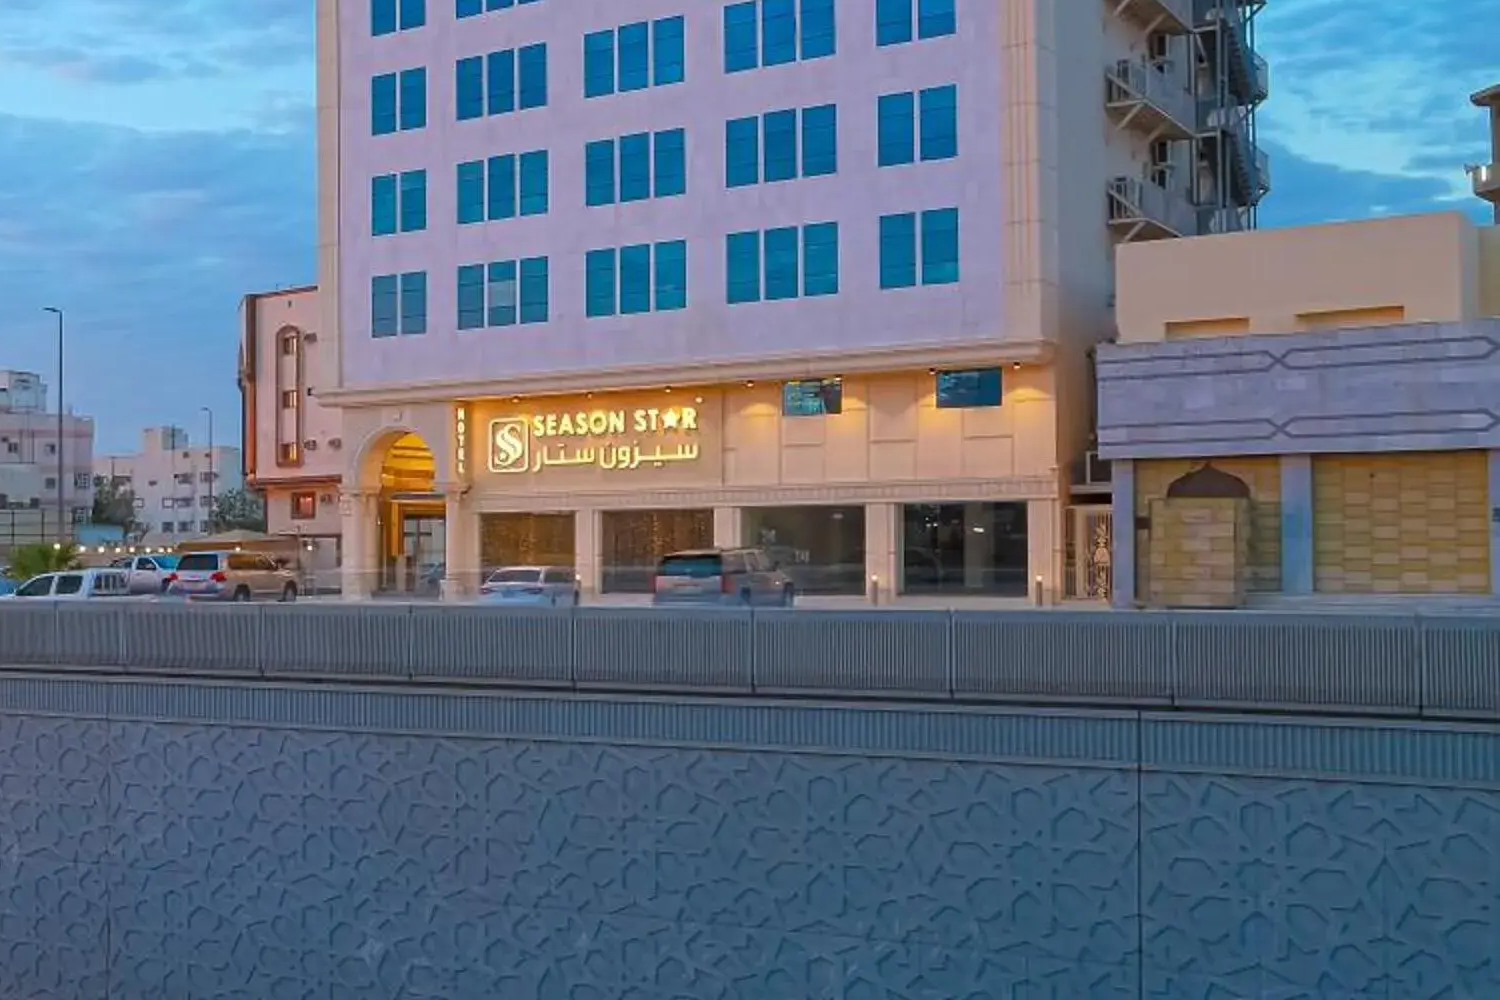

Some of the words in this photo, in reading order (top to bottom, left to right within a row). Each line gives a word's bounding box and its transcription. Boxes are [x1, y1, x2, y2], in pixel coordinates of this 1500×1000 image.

[533, 409, 626, 438] SEASON
[456, 407, 466, 474] HOTEL
[600, 440, 699, 470] سيزون
[532, 442, 595, 473] ستار
